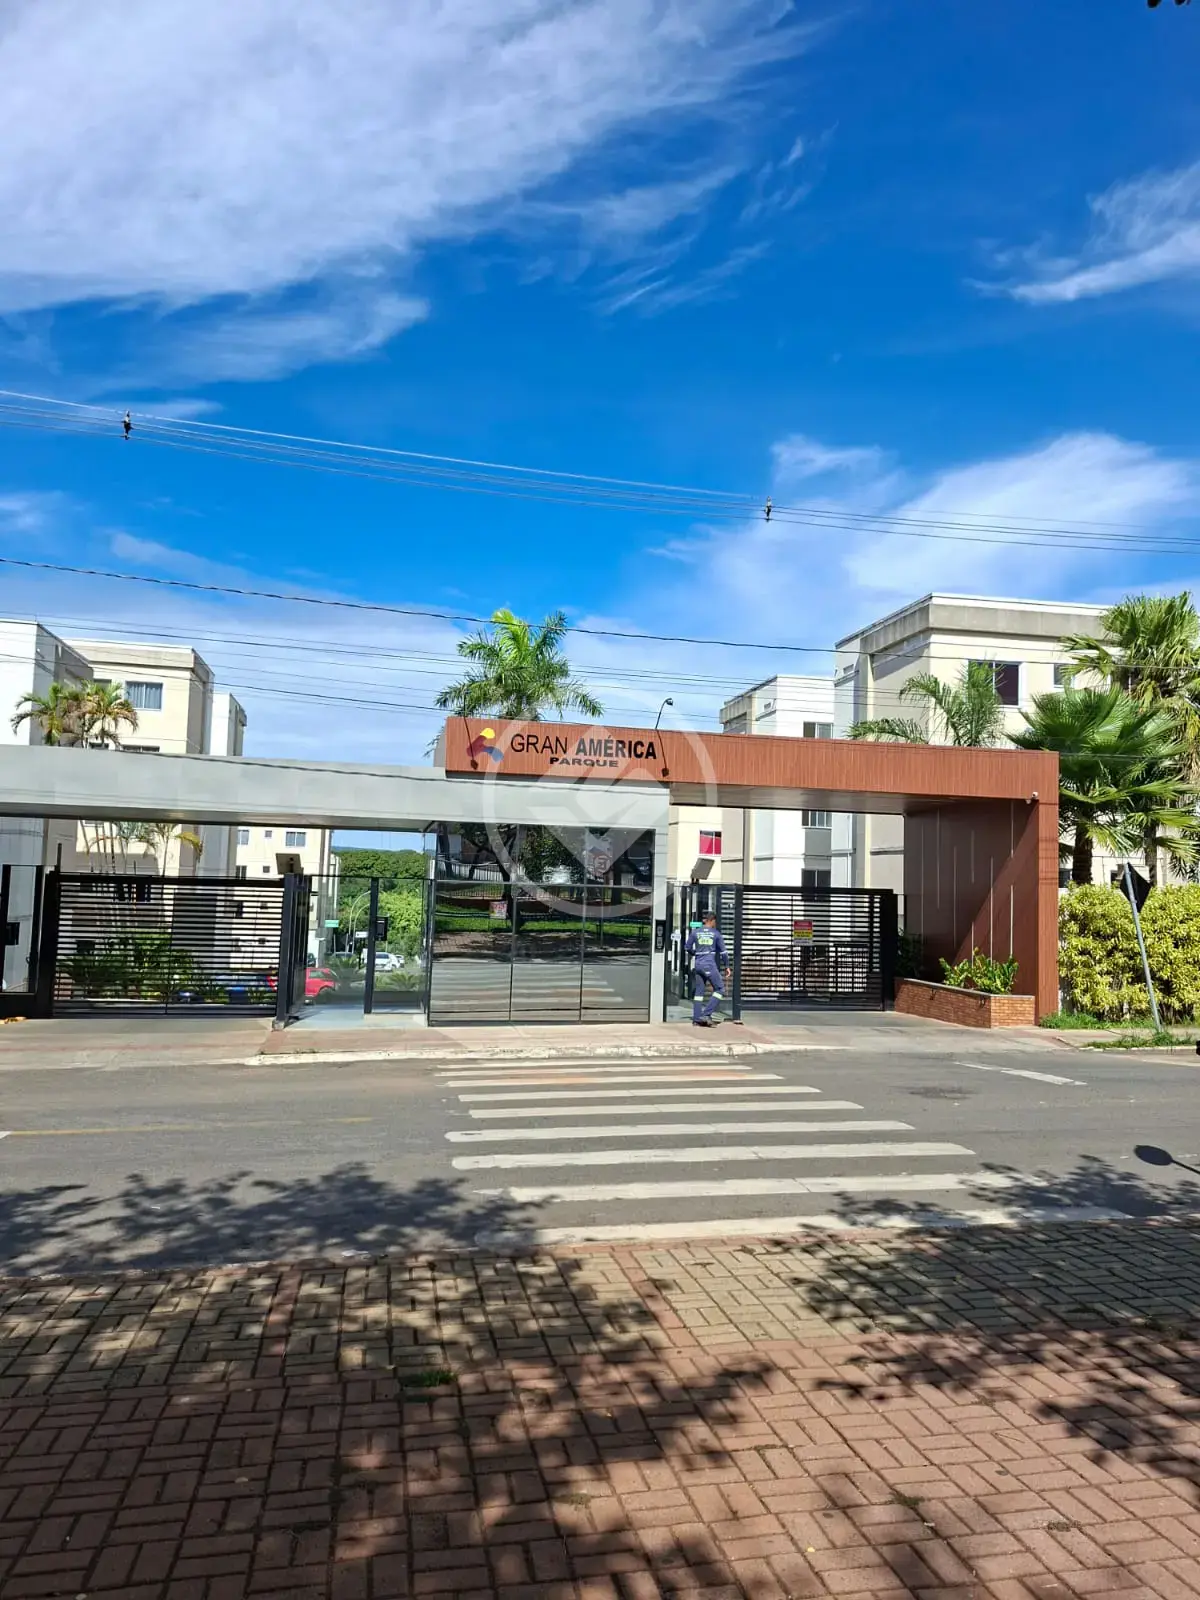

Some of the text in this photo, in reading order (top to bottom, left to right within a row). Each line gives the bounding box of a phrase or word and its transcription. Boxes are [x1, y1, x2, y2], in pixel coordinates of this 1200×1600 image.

[510, 733, 657, 760] GRAN AMÉRICA
[549, 757, 619, 767] PARQUE
